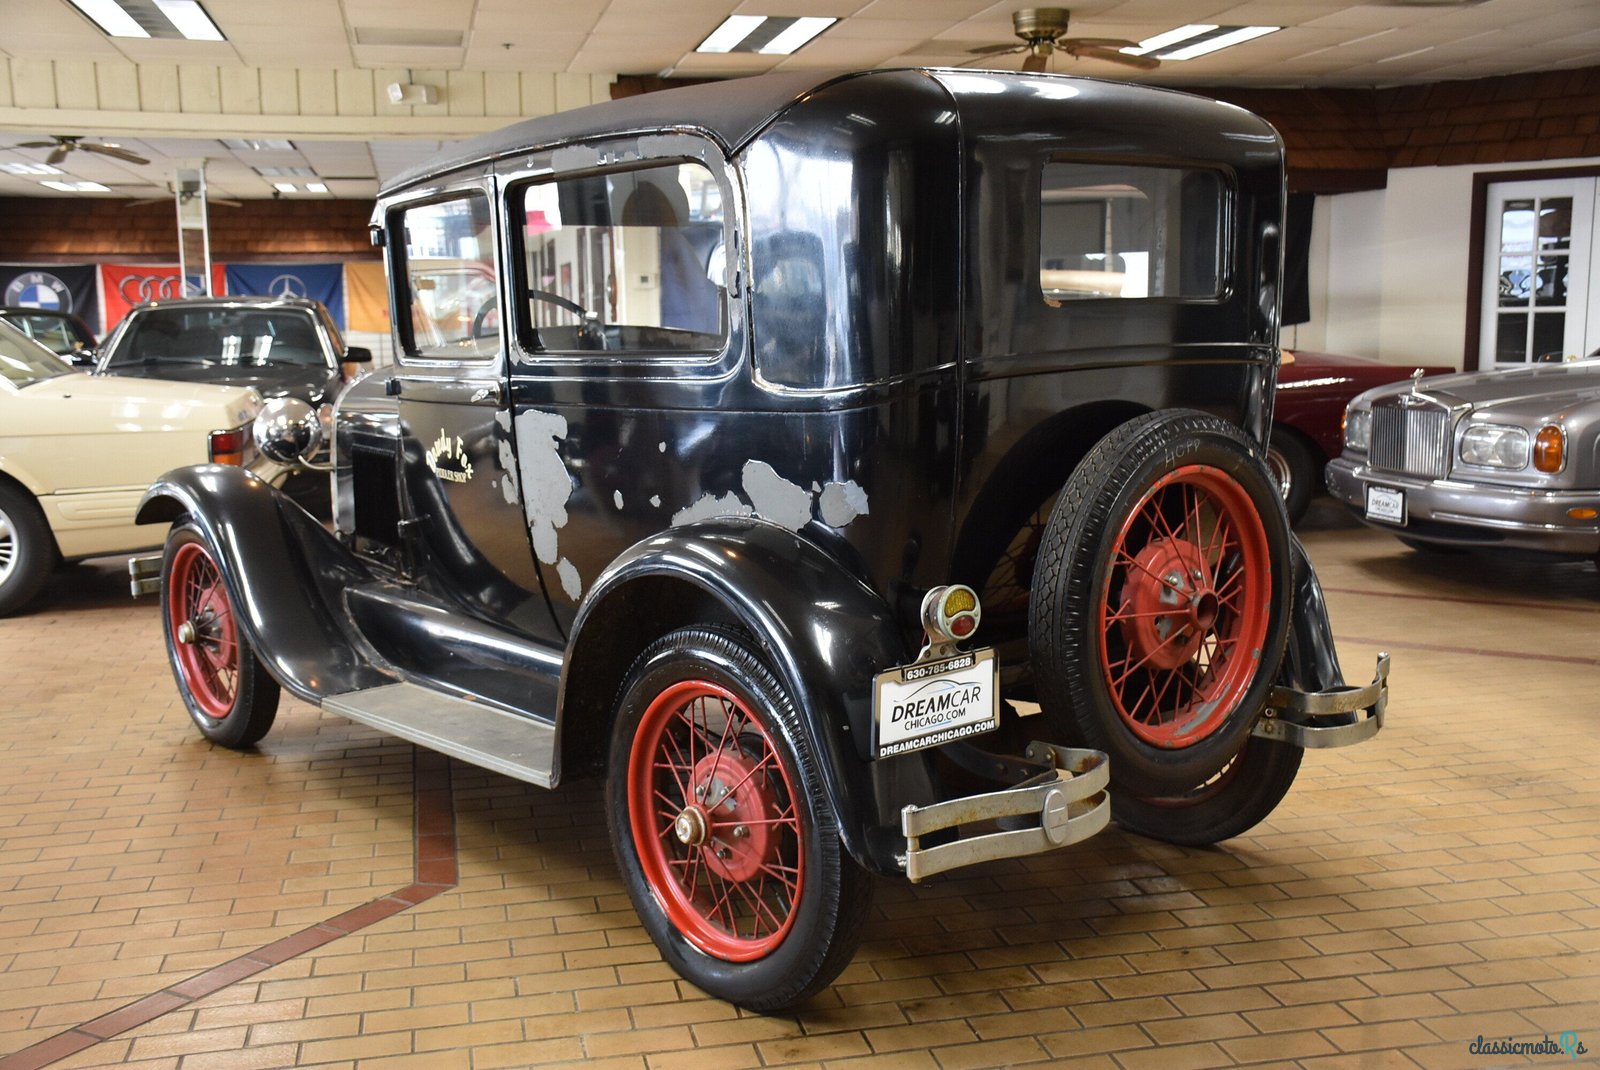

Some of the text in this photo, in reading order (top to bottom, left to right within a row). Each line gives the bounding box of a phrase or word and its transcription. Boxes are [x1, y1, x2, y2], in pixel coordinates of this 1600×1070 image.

[12, 272, 66, 293] BMW
[907, 657, 971, 680] 630-785-6828
[891, 686, 981, 723] DREAMCAR
[904, 707, 966, 731] CHICAGO.COM
[880, 719, 995, 757] DREAMCARCHICAGO.COM
